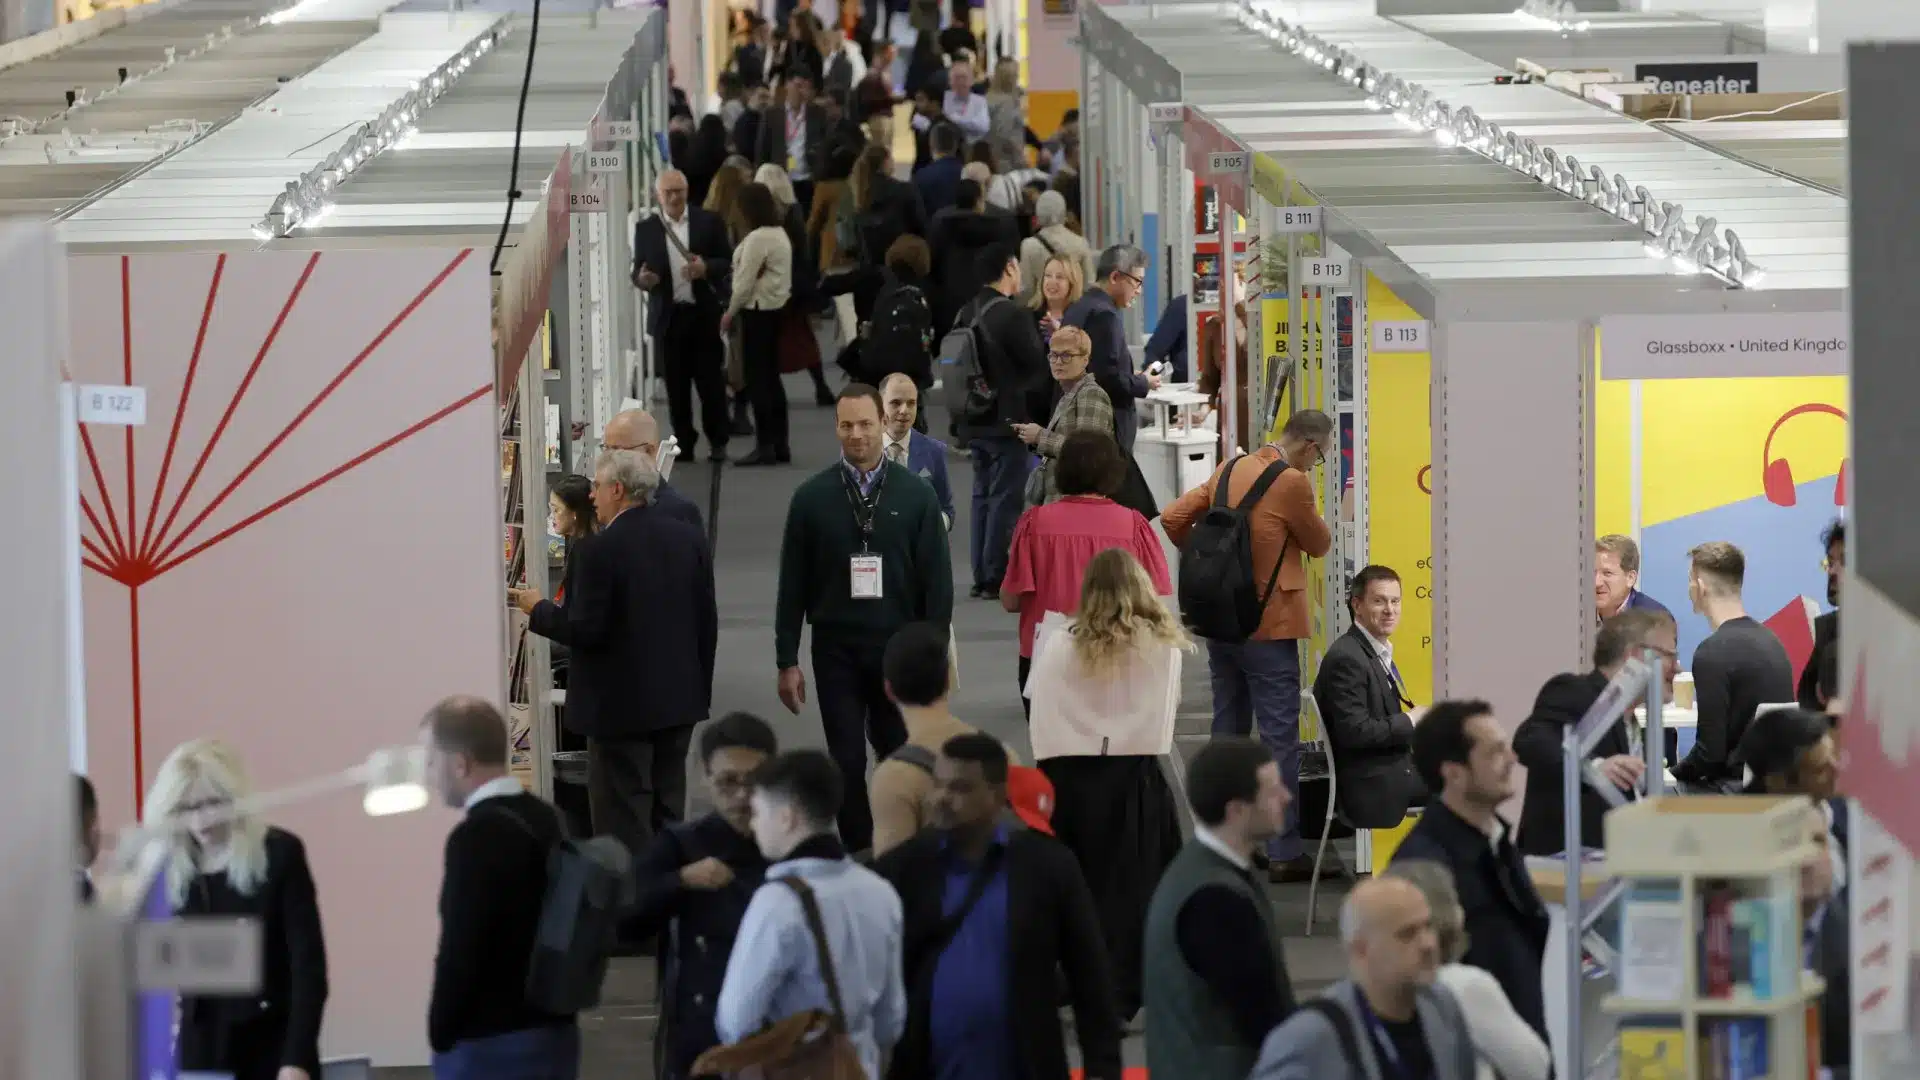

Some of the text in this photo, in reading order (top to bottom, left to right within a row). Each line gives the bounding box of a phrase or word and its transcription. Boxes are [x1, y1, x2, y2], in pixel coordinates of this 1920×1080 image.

[1643, 73, 1751, 94] Repeater
[609, 126, 632, 135] B 96
[590, 157, 618, 167] B 100
[1213, 157, 1242, 168] B 105
[571, 195, 600, 205] B 104
[1285, 212, 1312, 224] B 111
[1313, 263, 1342, 276] B 113
[1384, 327, 1417, 342] B 113
[1646, 338, 1847, 355] Glassboxx United Kingdo
[92, 393, 103, 410] B
